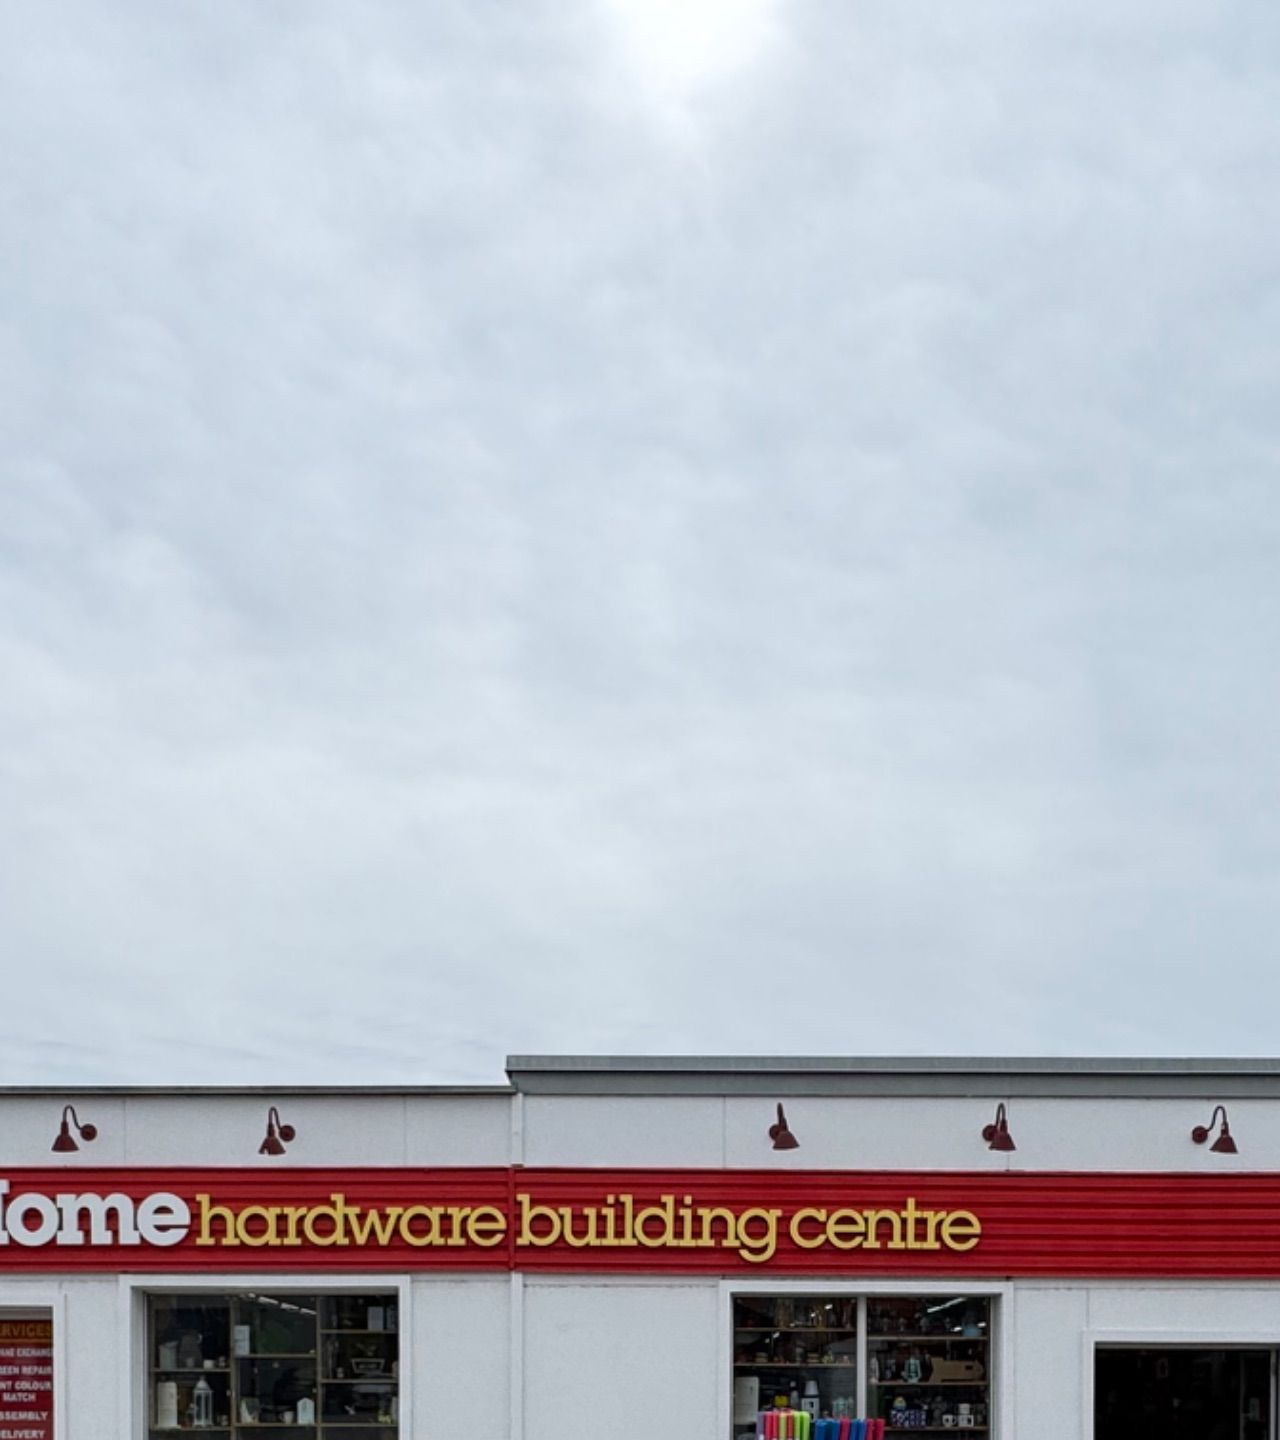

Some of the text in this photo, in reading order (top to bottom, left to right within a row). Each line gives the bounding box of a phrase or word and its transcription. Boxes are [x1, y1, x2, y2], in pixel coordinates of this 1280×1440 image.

[195, 1194, 507, 1247] hardware
[516, 1194, 782, 1263] building
[790, 1198, 982, 1251] centre
[2, 1392, 36, 1402] MATCH
